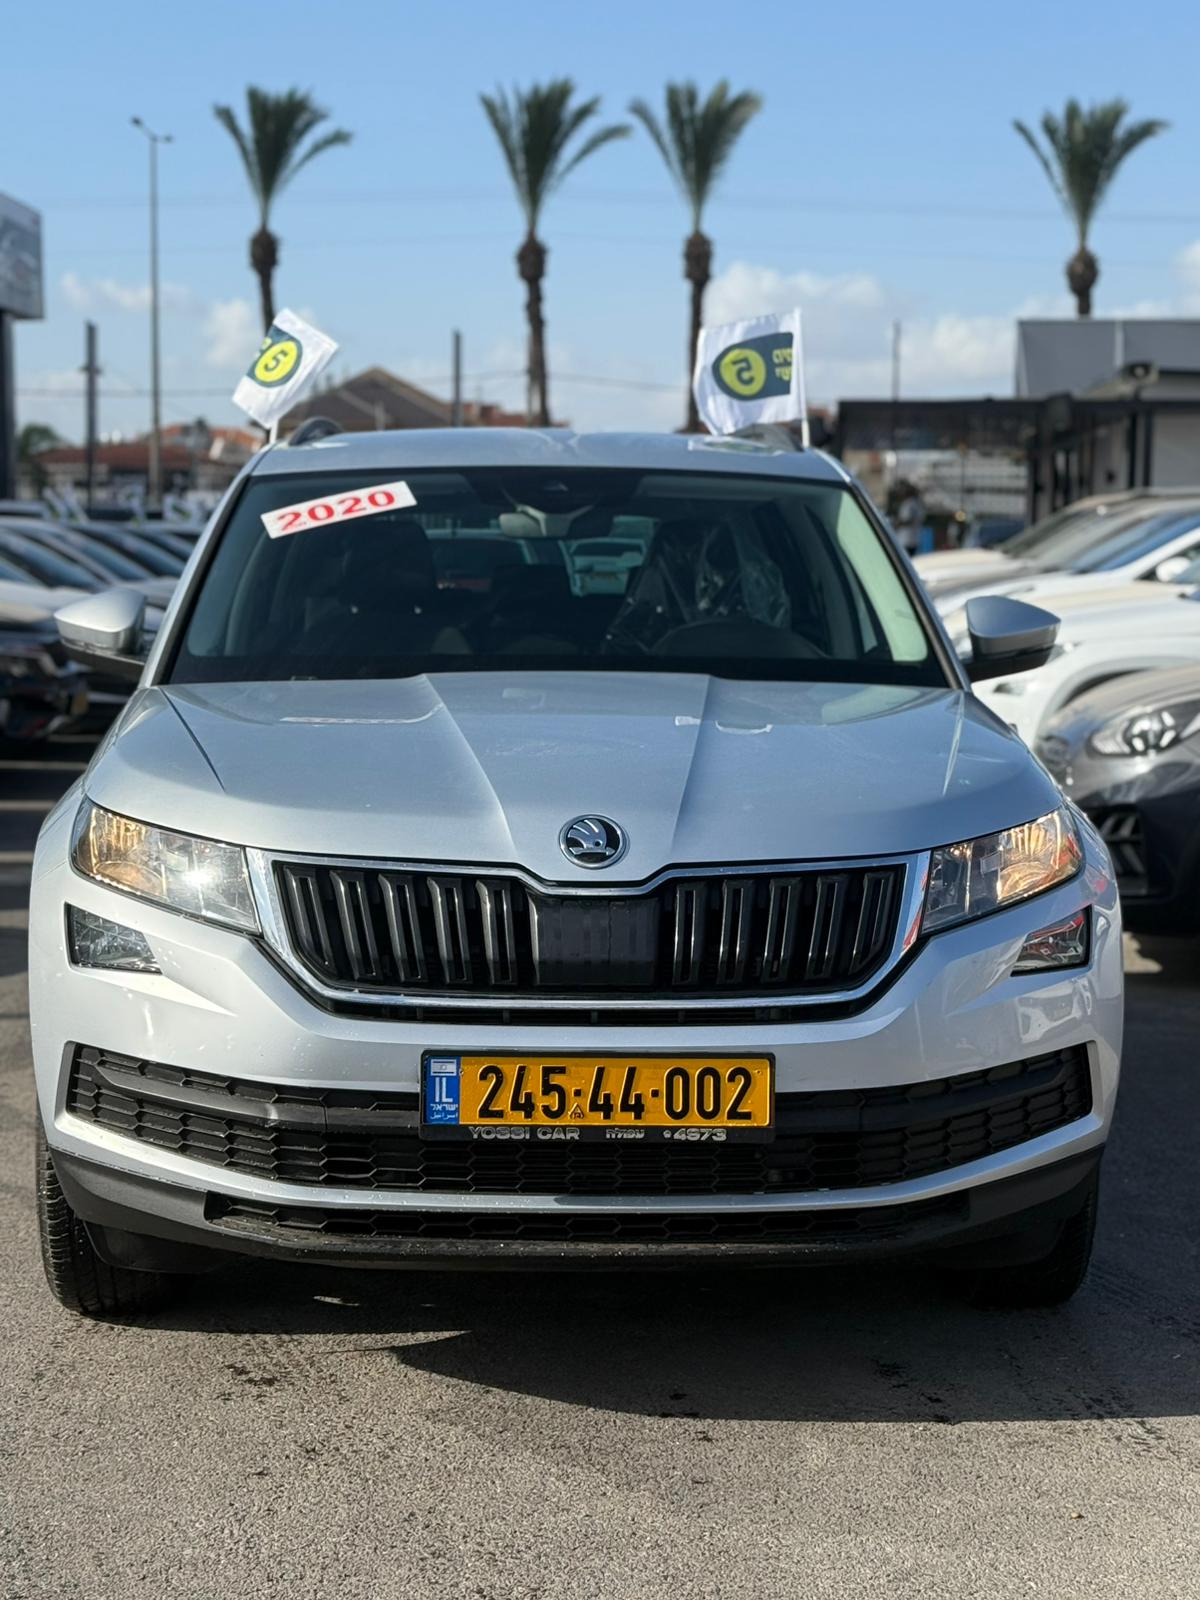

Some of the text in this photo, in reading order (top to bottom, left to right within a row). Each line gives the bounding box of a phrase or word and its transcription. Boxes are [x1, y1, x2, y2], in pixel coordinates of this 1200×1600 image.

[263, 349, 289, 373] 5
[276, 489, 396, 532] 2020
[435, 1077, 453, 1103] IL
[430, 1103, 458, 1111] ישראל
[468, 1126, 580, 1140] YOSSI CAR
